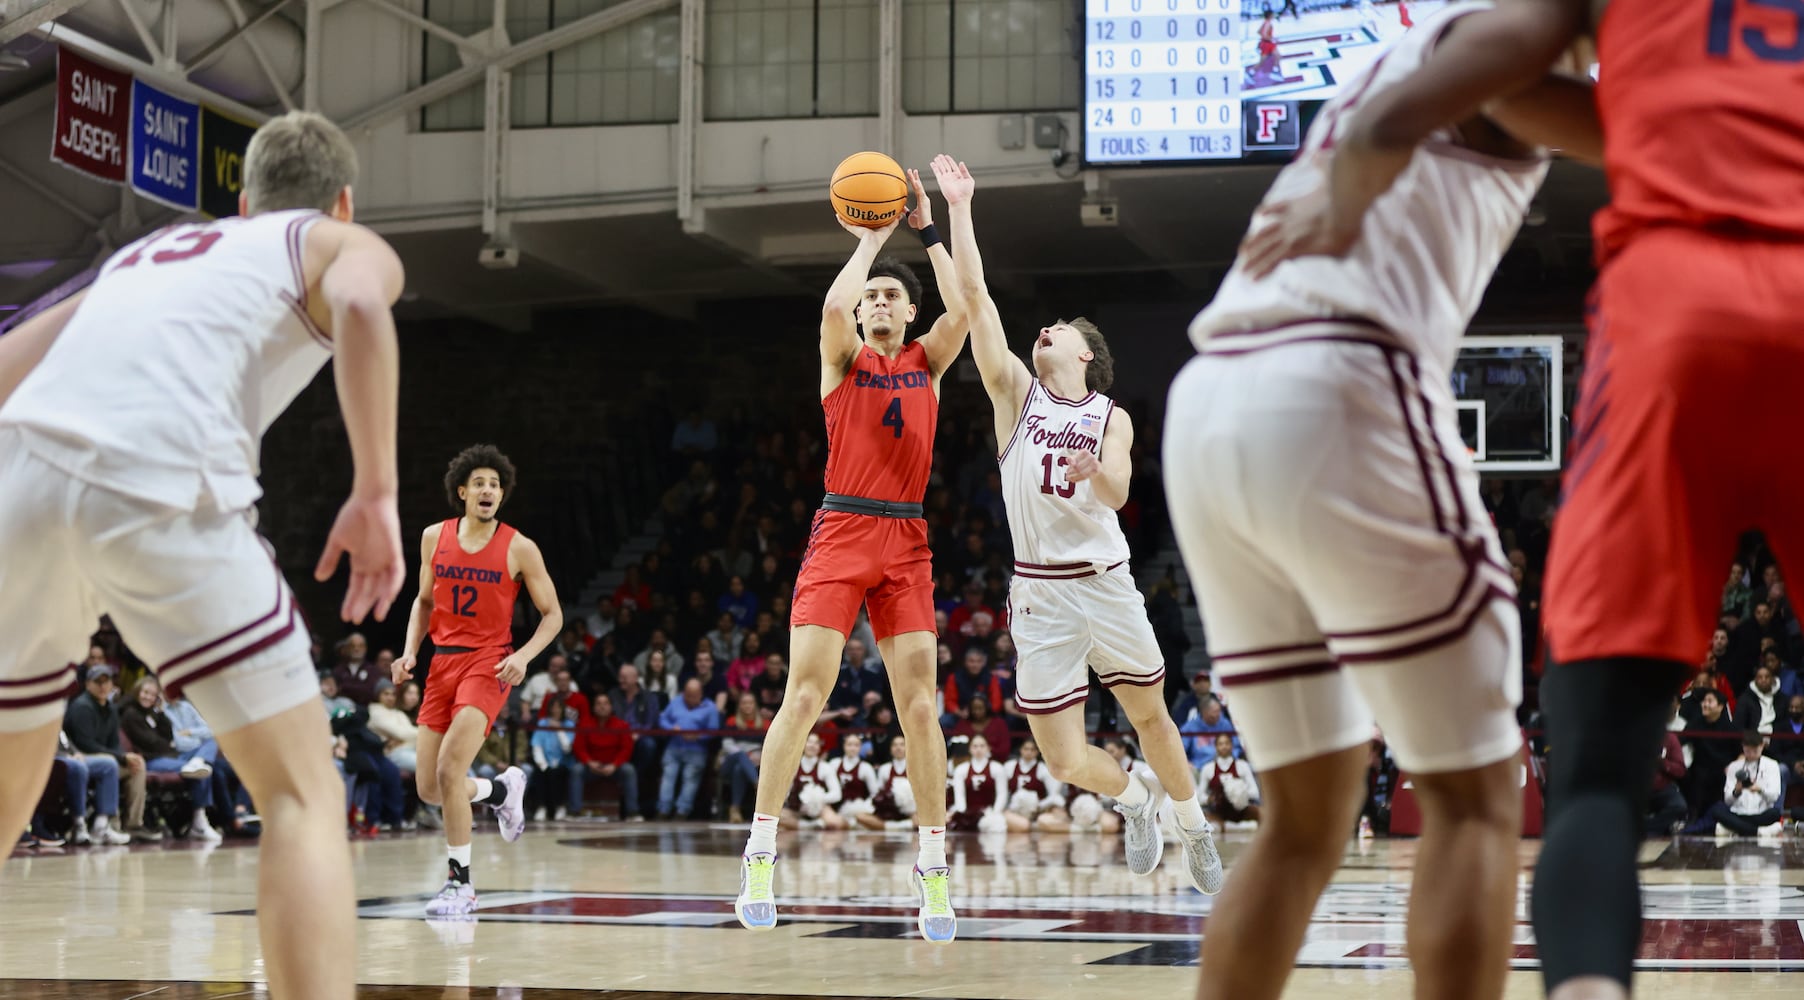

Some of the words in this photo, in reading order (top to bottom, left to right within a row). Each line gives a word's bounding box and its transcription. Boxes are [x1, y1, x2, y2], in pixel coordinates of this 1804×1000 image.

[1096, 21, 1114, 40] 12
[1131, 20, 1141, 39] 0
[1167, 19, 1177, 38] 0
[1197, 18, 1207, 37] 0
[1219, 17, 1229, 36] 0
[1096, 50, 1114, 68] 13
[1131, 49, 1141, 68] 0
[1167, 48, 1177, 66] 0
[1197, 47, 1207, 65] 0
[1219, 46, 1229, 65] 0
[71, 70, 117, 116] SAINT
[1096, 79, 1115, 98] 15
[1131, 78, 1141, 97] 2
[1170, 77, 1177, 96] 1
[1197, 76, 1207, 95] 0
[1223, 76, 1229, 95] 1
[144, 102, 188, 148] SAINT
[1094, 108, 1114, 127] 24
[1131, 107, 1141, 126] 0
[1170, 106, 1177, 125] 1
[1197, 106, 1207, 124] 0
[1219, 105, 1229, 124] 0
[1259, 107, 1284, 139] F
[1100, 138, 1150, 156] FOULS:
[1160, 137, 1169, 154] 4
[1190, 136, 1218, 155] TOL:
[1222, 136, 1231, 153] 3
[142, 144, 188, 189] LOUIS
[846, 205, 896, 221] Wilson
[882, 397, 904, 438] 4
[1025, 415, 1098, 455] Fordham
[1041, 453, 1076, 498] 13
[435, 564, 503, 584] DAYTON
[452, 584, 478, 617] 12
